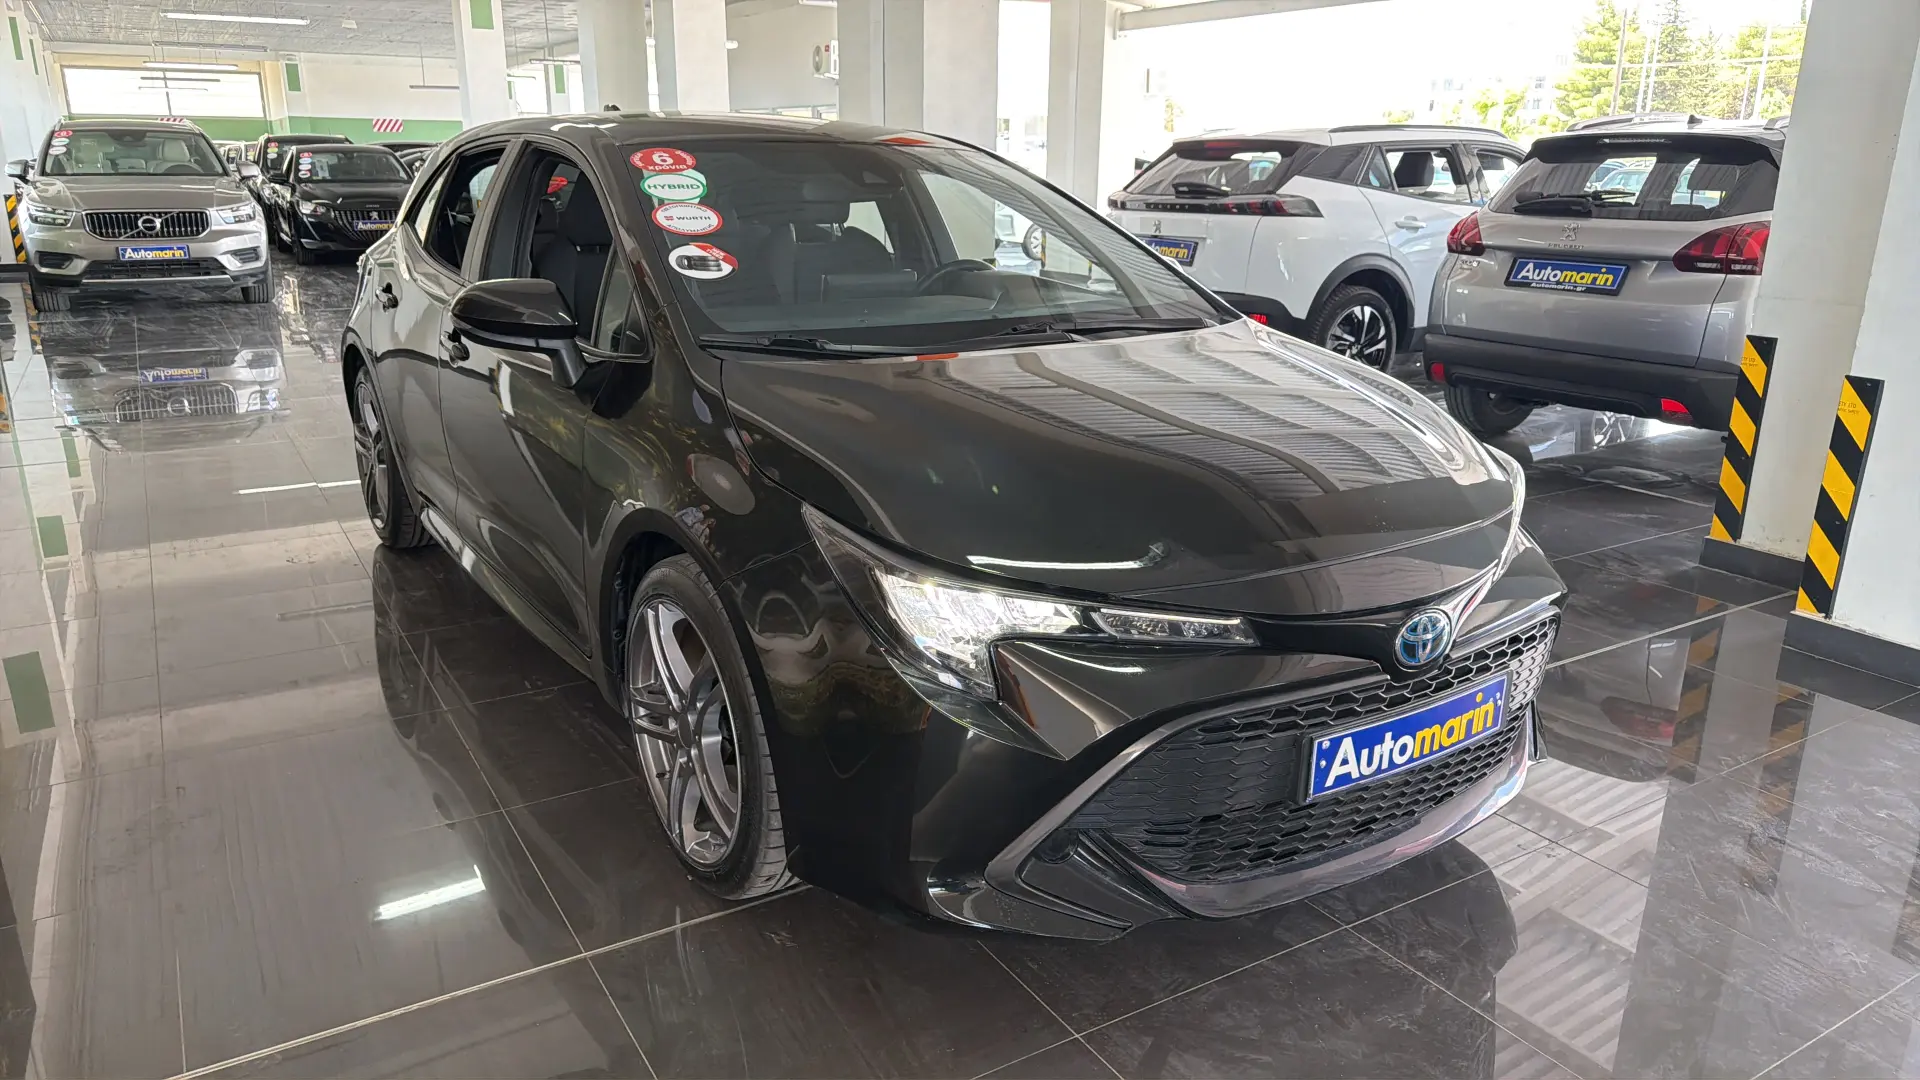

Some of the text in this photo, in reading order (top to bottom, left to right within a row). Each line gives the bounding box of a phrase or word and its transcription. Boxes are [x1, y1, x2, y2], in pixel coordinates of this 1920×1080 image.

[652, 152, 674, 165] 6
[125, 246, 184, 258] Automarin
[1517, 262, 1614, 286] Automarin
[1530, 282, 1587, 292] Automarin.gr
[1324, 692, 1495, 788] Automarin
